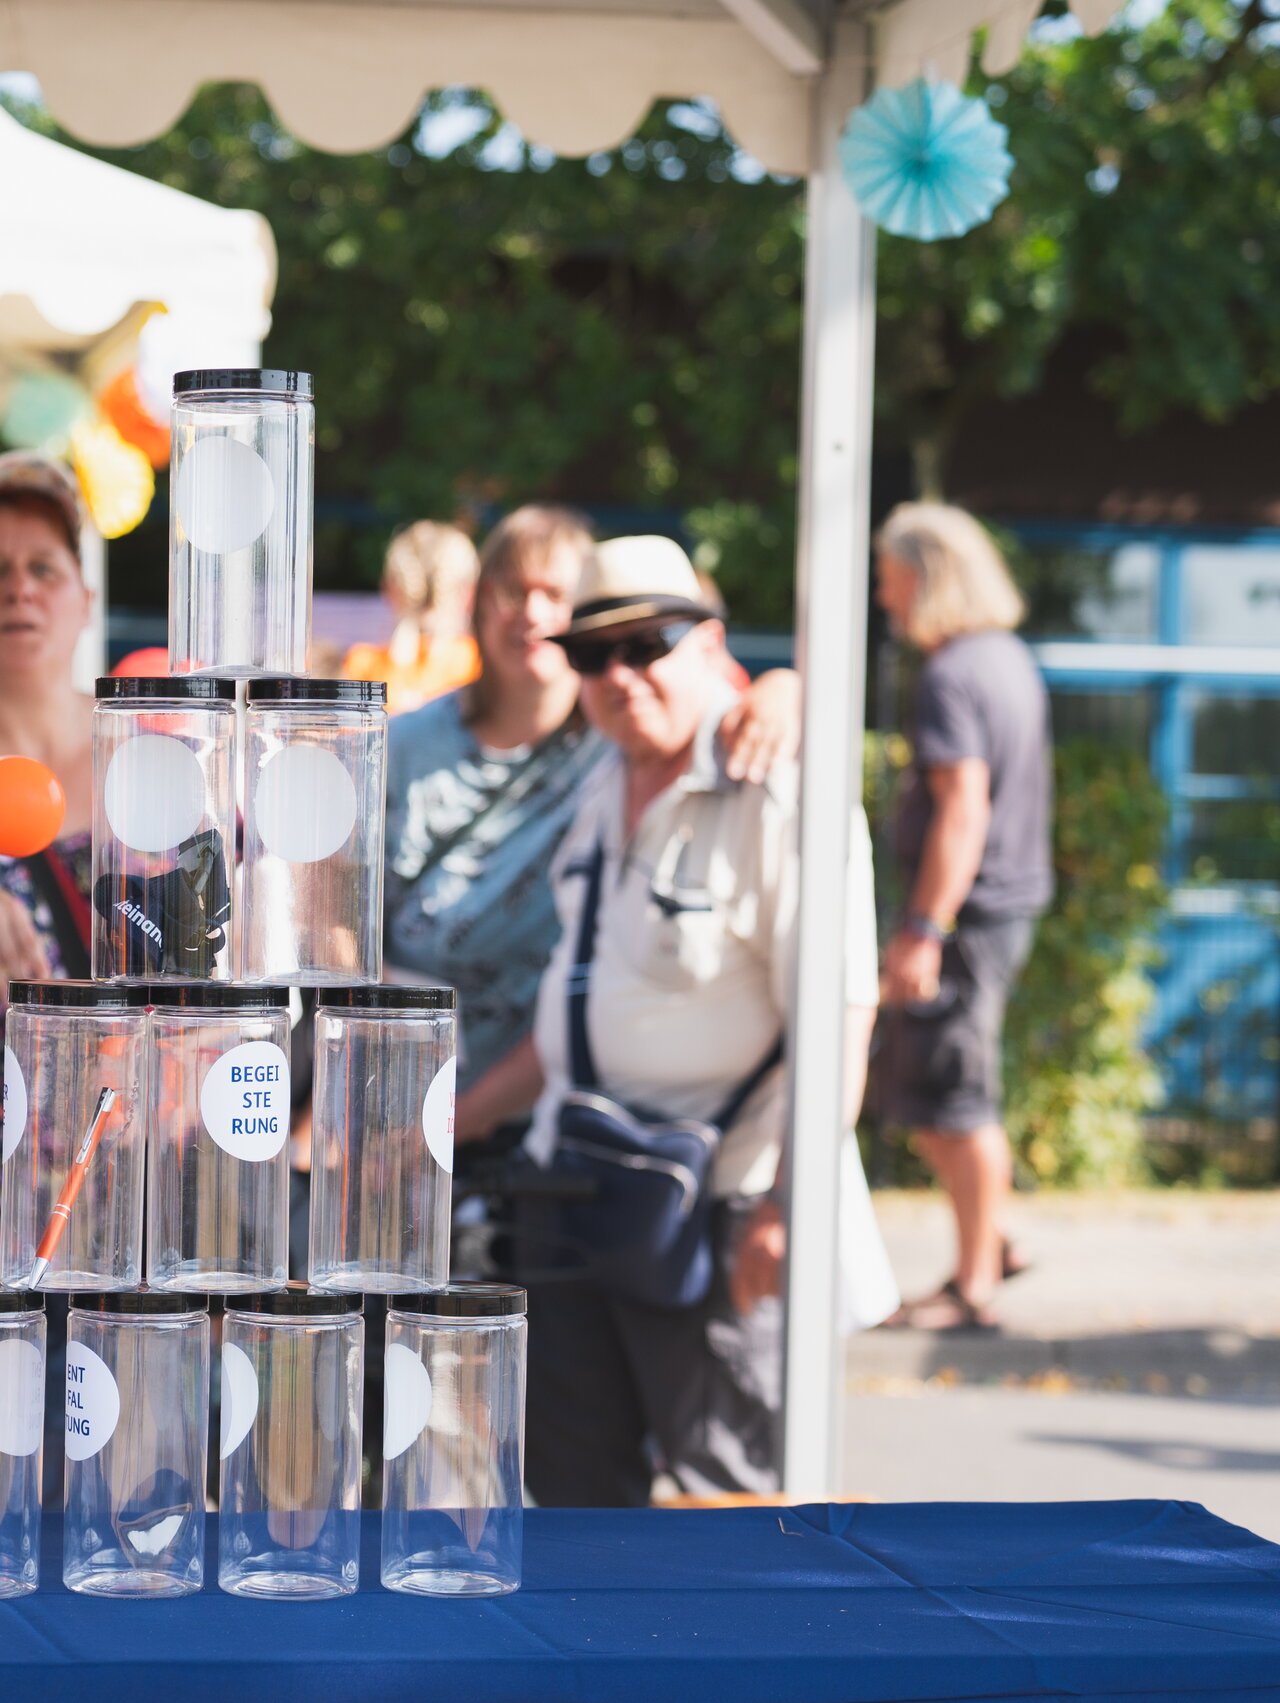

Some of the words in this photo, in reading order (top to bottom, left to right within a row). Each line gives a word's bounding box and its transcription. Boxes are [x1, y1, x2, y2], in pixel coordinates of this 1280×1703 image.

[231, 1065, 279, 1082] BEGEI
[242, 1091, 271, 1108] STE
[232, 1117, 278, 1134] RUNG
[67, 1363, 86, 1383] ENT
[67, 1389, 84, 1410] FAL
